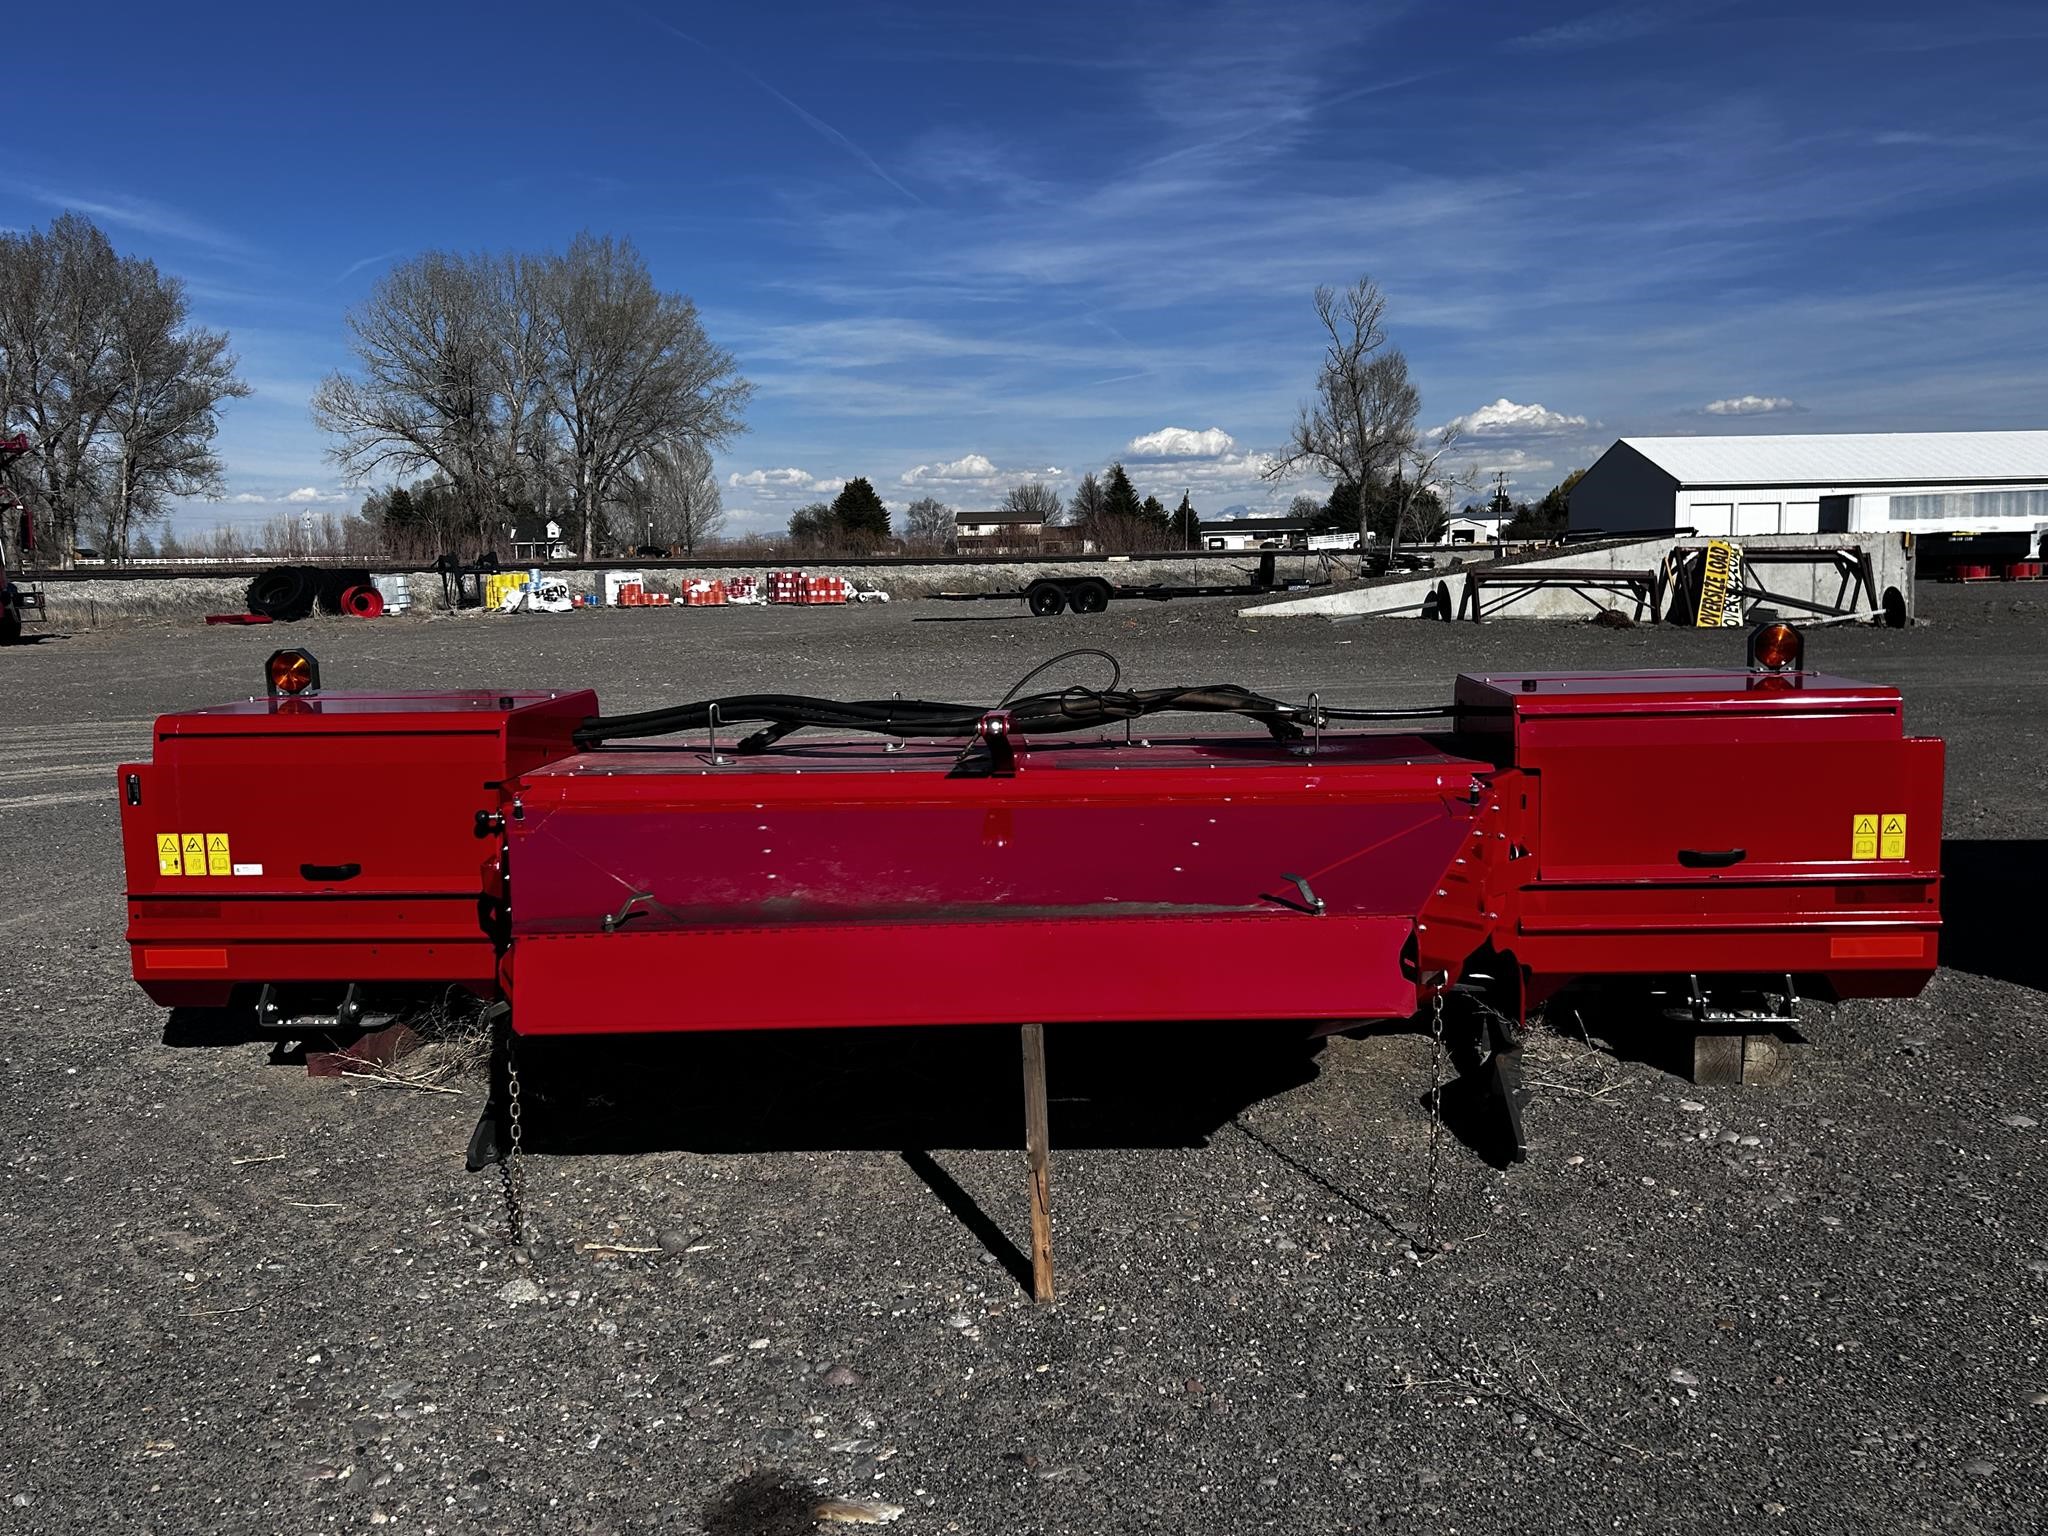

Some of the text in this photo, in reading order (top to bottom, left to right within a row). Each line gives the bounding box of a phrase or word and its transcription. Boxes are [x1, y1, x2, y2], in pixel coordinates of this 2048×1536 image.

[1699, 546, 1729, 626] OVERSIZE LOAD
[1723, 577, 1742, 627] OVERS
